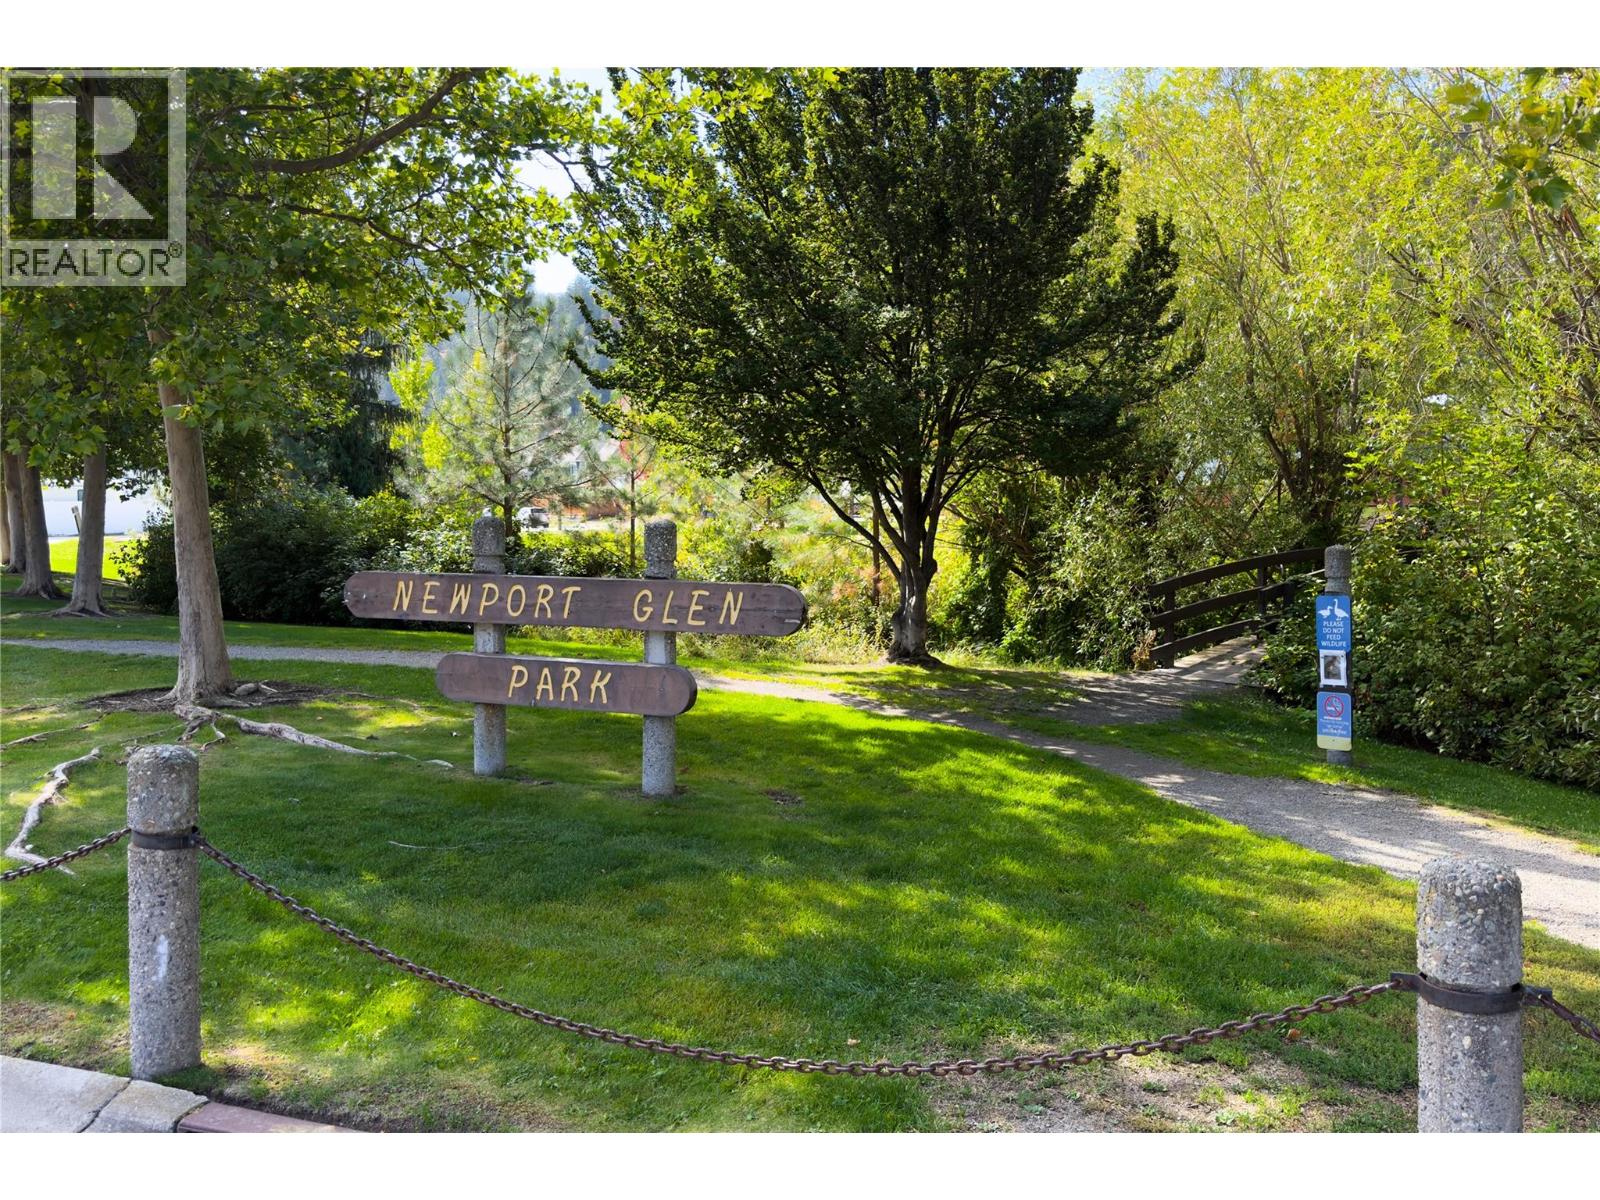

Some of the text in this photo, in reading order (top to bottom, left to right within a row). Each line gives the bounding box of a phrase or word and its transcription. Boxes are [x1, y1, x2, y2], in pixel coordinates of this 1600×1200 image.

[393, 580, 744, 626] NEWPORT GLEN
[1322, 620, 1344, 628] PLEASE
[1320, 640, 1347, 648] WILDLIFE
[507, 664, 612, 704] PARK
